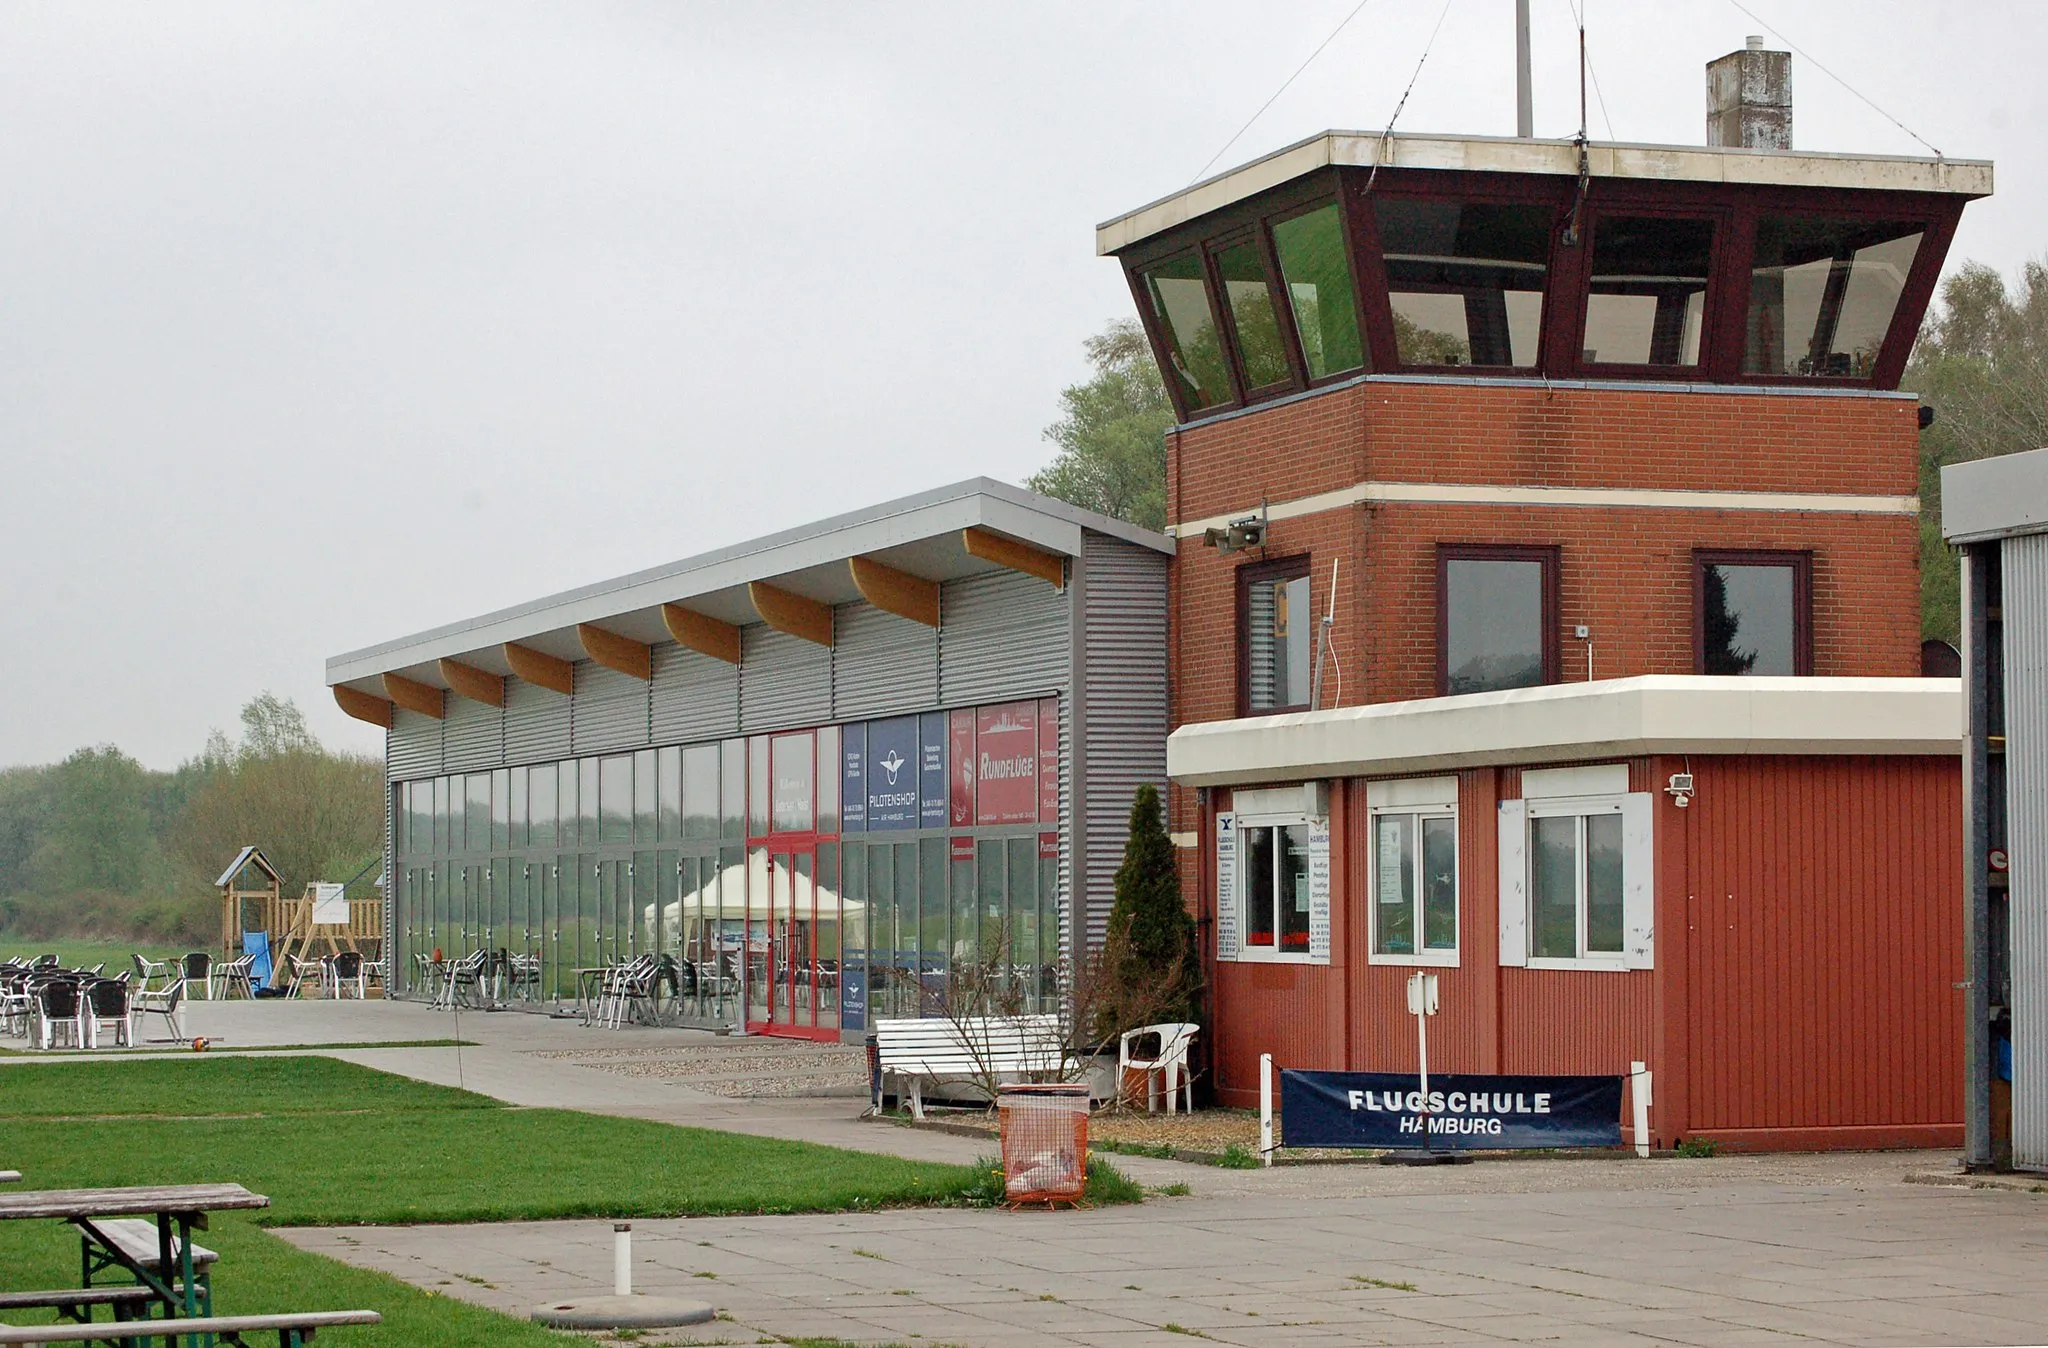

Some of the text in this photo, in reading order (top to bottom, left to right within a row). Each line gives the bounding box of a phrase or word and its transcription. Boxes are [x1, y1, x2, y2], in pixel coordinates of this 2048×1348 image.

[980, 752, 1033, 780] RUNDFLÜGE
[869, 792, 916, 808] PILOTENSHOP
[1348, 1090, 1551, 1114] FLUGSCHULE
[1399, 1116, 1502, 1135] HAMBURG
